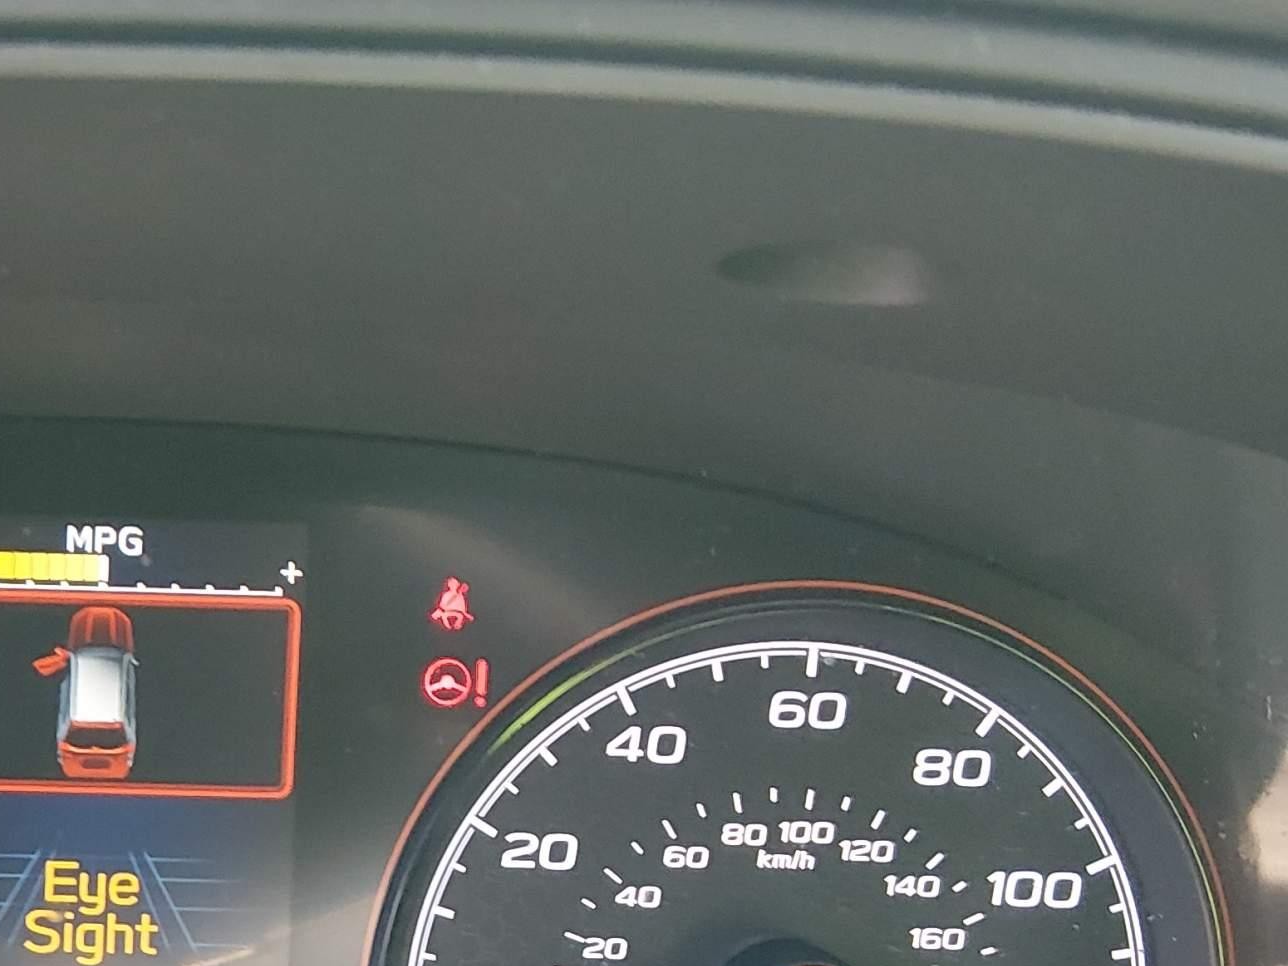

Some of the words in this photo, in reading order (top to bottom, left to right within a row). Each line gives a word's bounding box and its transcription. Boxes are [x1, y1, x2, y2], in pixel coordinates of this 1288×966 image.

[65, 524, 144, 555] MPG
[768, 690, 847, 730] 60
[605, 725, 687, 765] 40
[912, 748, 992, 788] 80
[720, 822, 768, 847] 80
[778, 820, 836, 845] 100
[500, 832, 578, 871] 20
[662, 845, 710, 869] 60
[756, 848, 816, 870] km/h
[838, 839, 896, 863] 120
[43, 860, 140, 915] Eye
[614, 885, 662, 909] 40
[883, 874, 941, 898] 140
[986, 870, 1083, 909] 100
[23, 909, 159, 966] Sight
[580, 936, 628, 960] 20
[909, 927, 966, 951] 160
